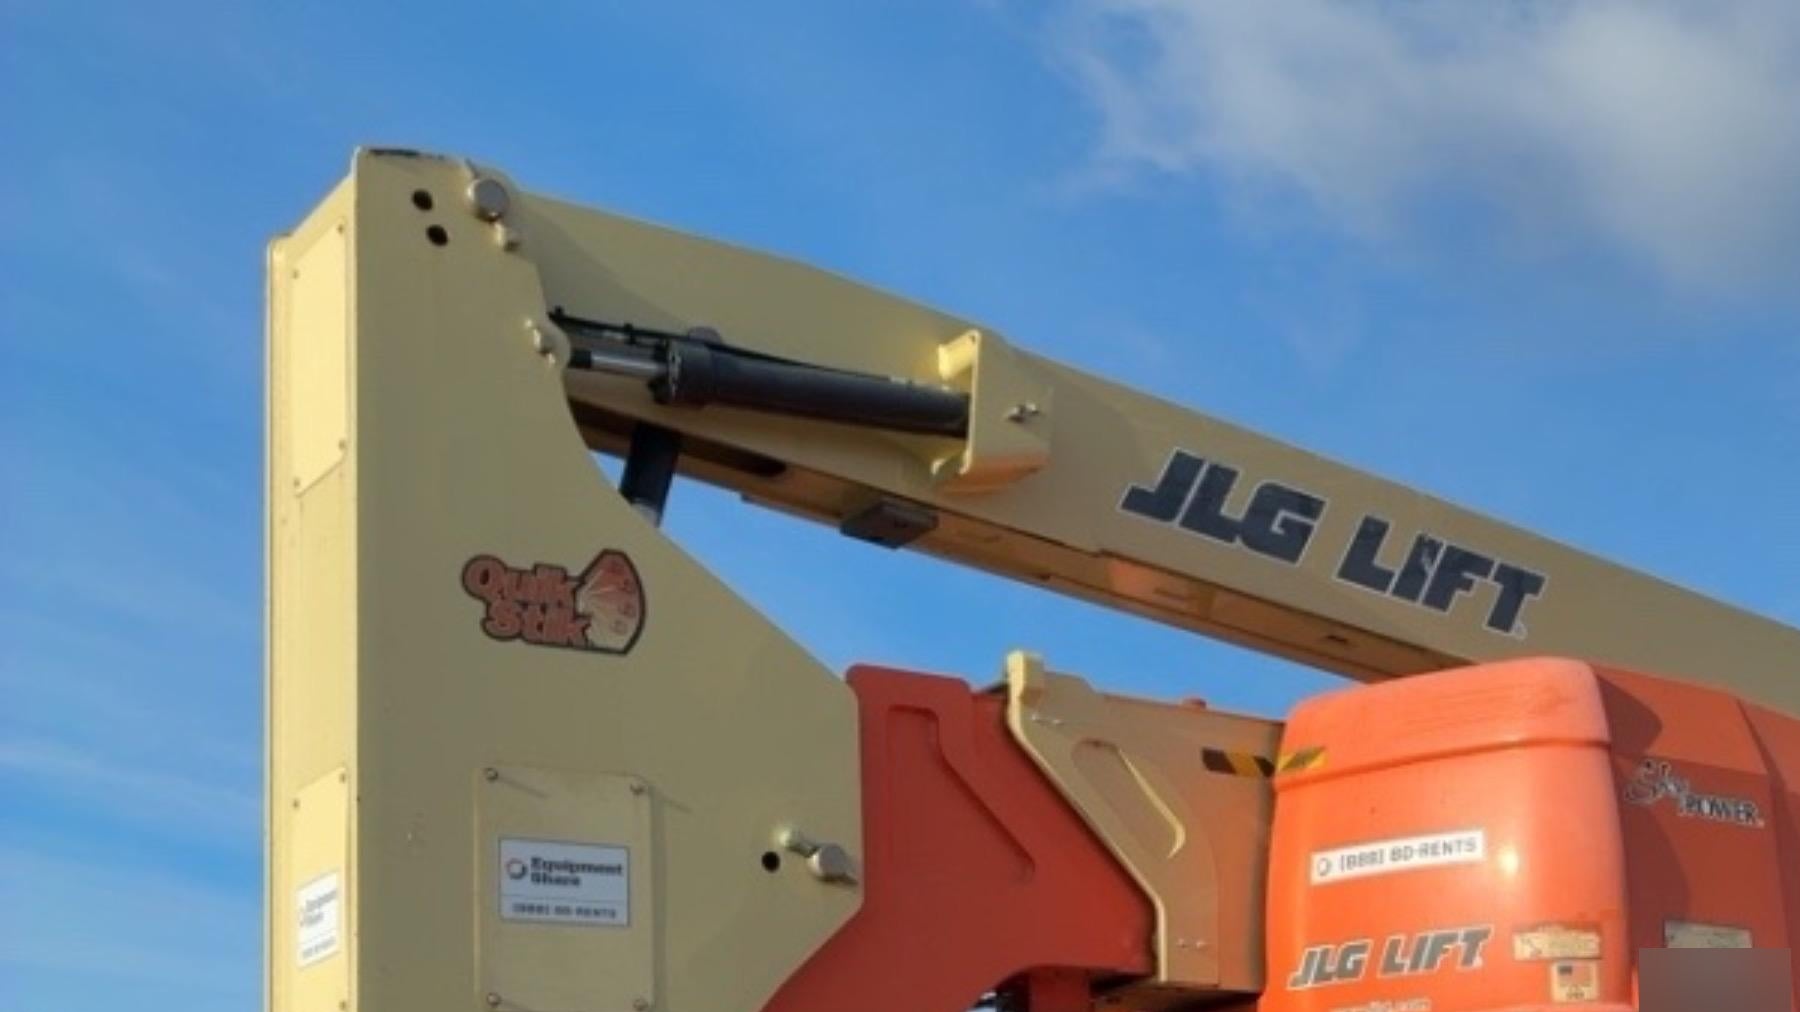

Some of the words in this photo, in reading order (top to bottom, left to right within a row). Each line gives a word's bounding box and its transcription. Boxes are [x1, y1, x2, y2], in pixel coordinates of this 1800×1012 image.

[1119, 446, 1329, 567] JLG
[1332, 513, 1548, 637] LIFT
[1287, 938, 1374, 991] JLG
[1377, 923, 1494, 979] LIFT
